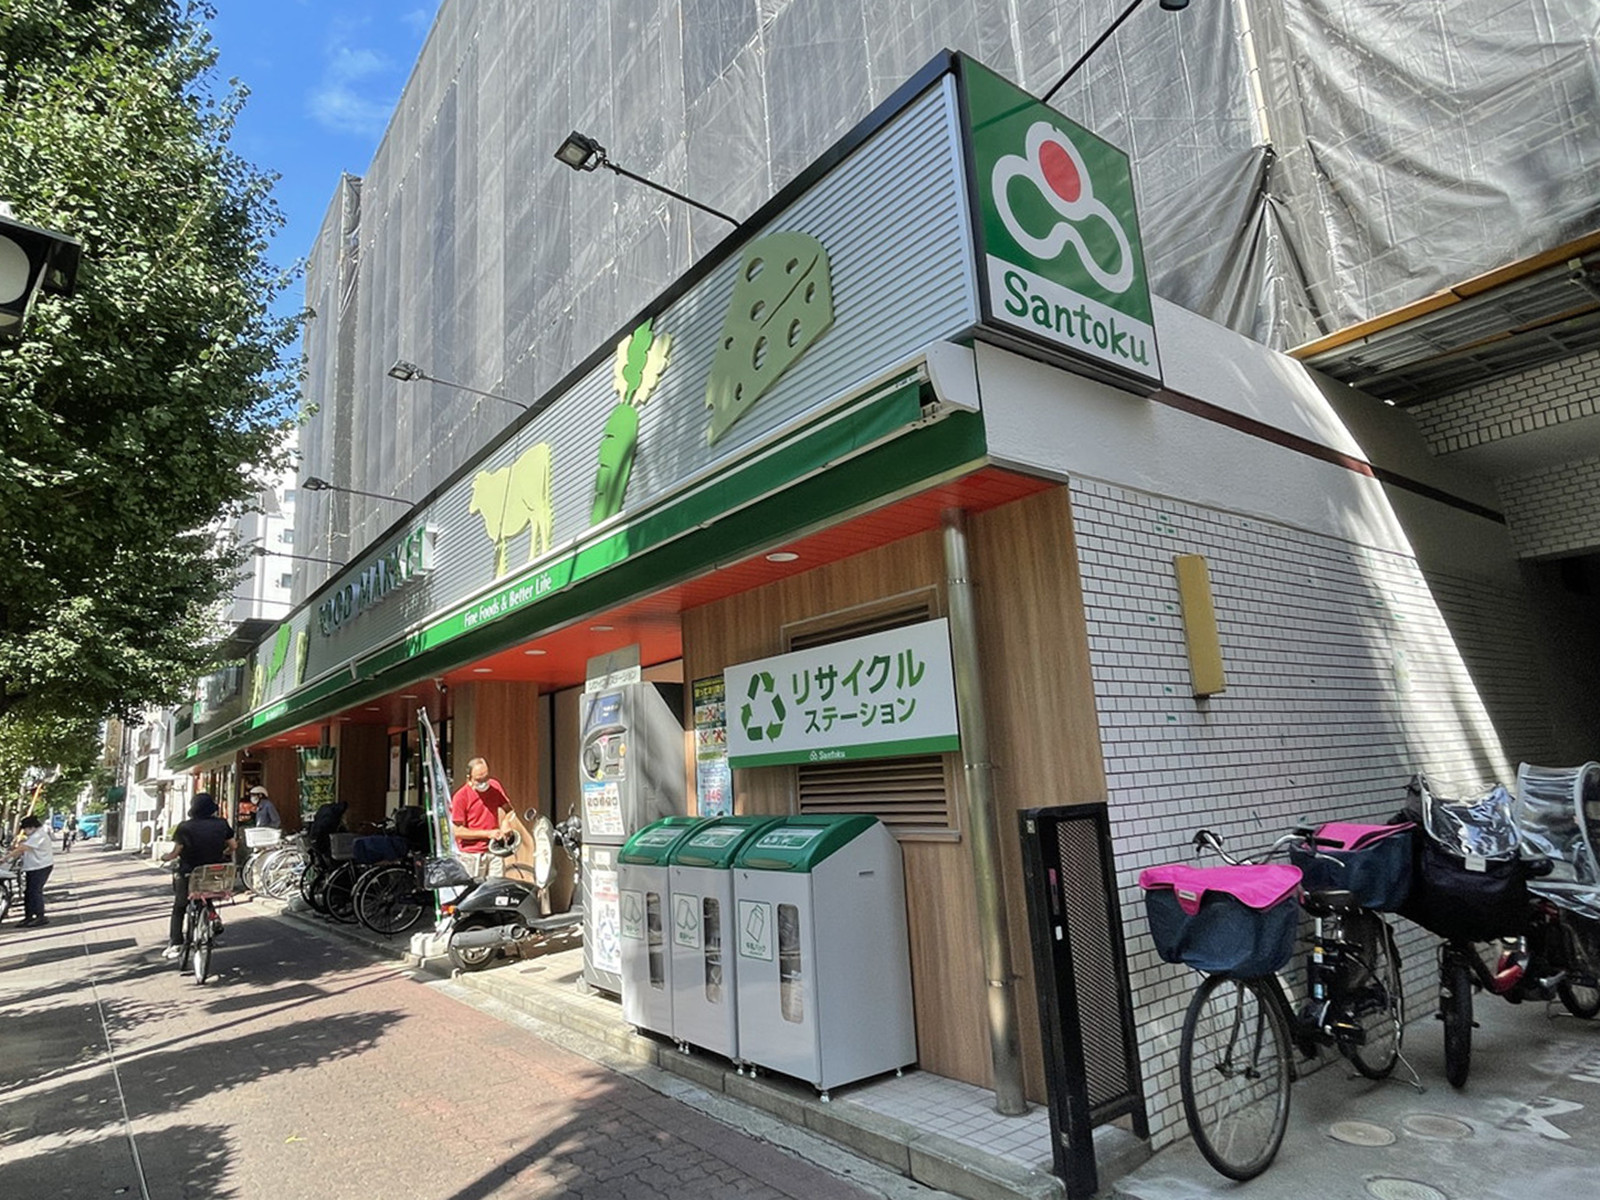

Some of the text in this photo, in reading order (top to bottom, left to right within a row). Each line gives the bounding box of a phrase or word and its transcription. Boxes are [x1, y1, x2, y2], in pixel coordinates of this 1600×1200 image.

[1004, 270, 1149, 366] Santoku
[464, 611, 478, 628] Fine
[479, 598, 500, 620] Foods
[509, 586, 533, 608] Better
[535, 572, 552, 595] Life
[792, 649, 925, 706] リサイクル
[805, 697, 916, 734] ステーション
